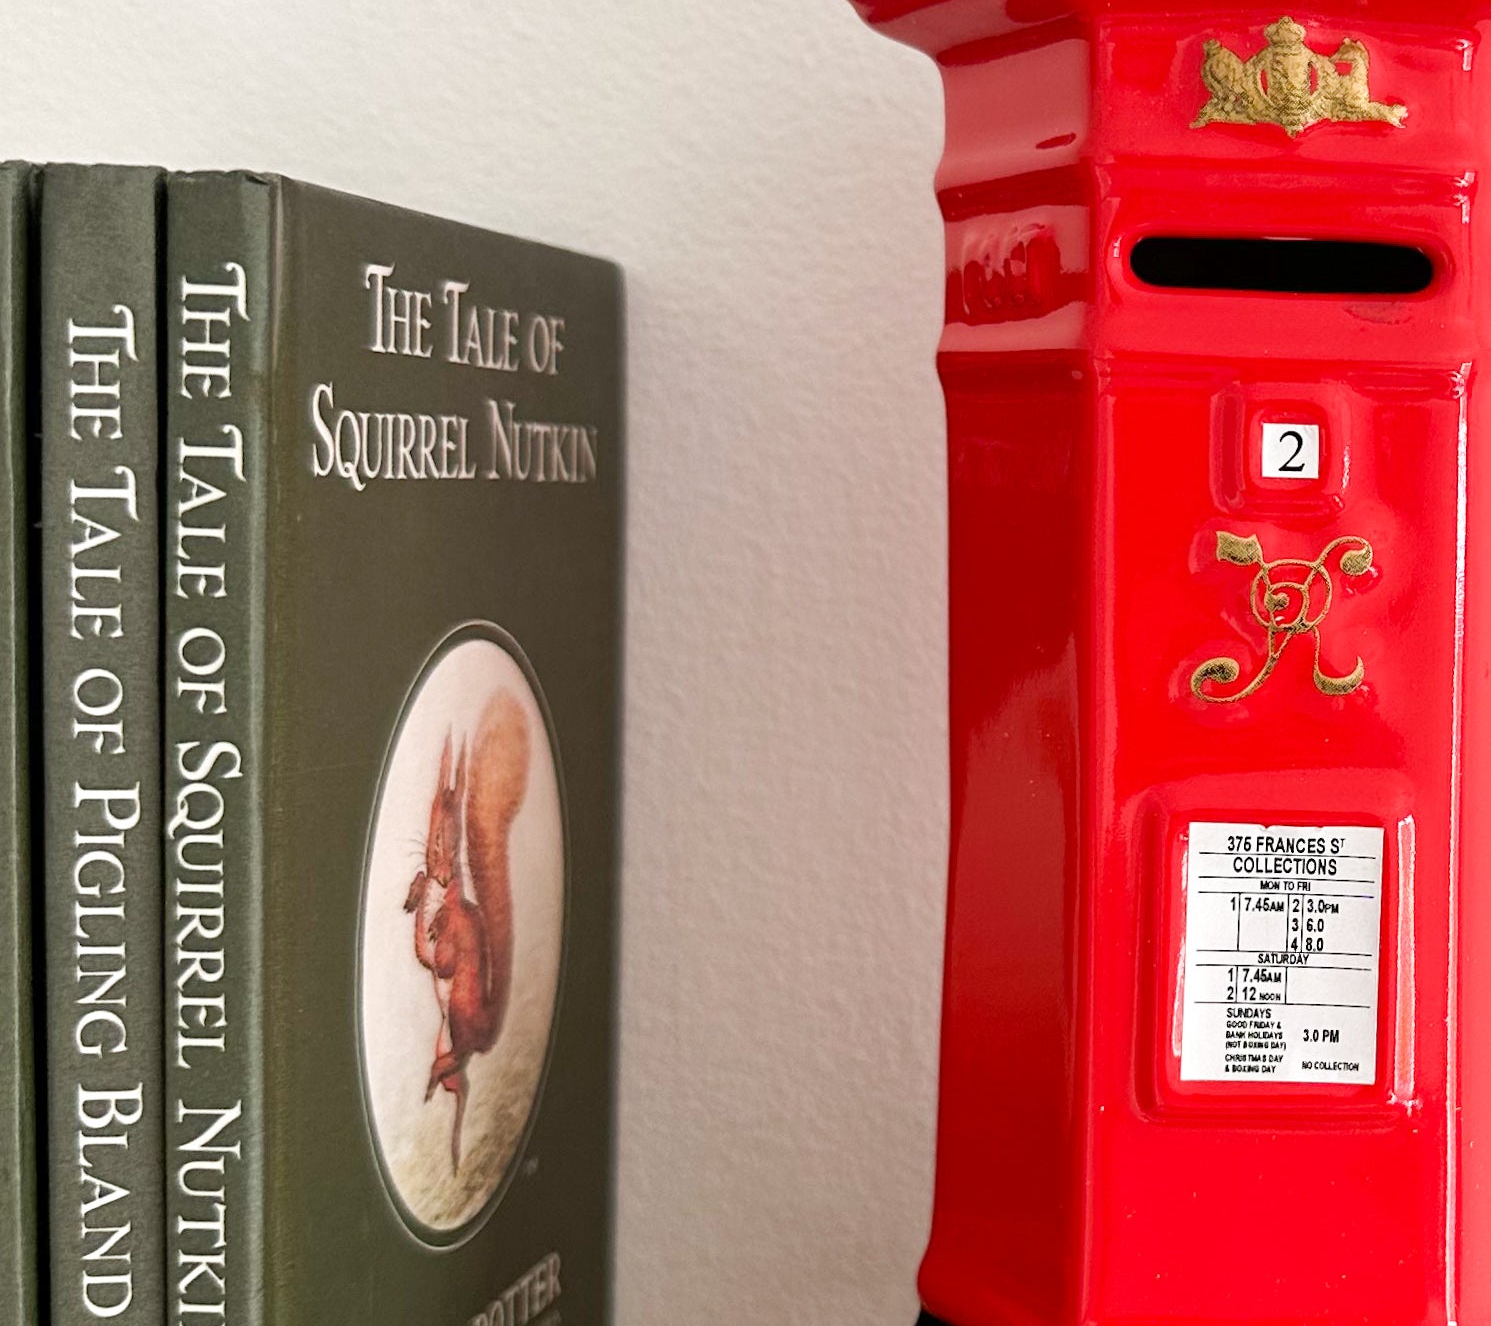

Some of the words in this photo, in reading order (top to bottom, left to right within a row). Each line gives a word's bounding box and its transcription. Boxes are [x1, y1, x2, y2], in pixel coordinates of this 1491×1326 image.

[365, 262, 434, 357] THE
[443, 281, 519, 372] TALE
[528, 315, 564, 375] OF
[181, 261, 250, 399] THE
[67, 304, 138, 441] THE
[311, 382, 476, 491] SQUIRREL
[487, 399, 597, 483] NUTKIN
[1278, 431, 1305, 472] 2
[174, 424, 246, 598] TALE
[68, 466, 139, 640] TALE
[178, 627, 227, 714] OF
[73, 668, 125, 755] OF
[1256, 836, 1325, 854] FRANCES
[1233, 857, 1337, 875] COLLECTIONS
[1260, 880, 1280, 890] MON
[1283, 881, 1295, 891] TO
[1297, 881, 1311, 892] FRI
[167, 740, 243, 1069] SQUIRREL
[1230, 897, 1236, 911] 1
[1245, 898, 1284, 912] 7.45AM
[1292, 898, 1300, 913] 2
[1307, 898, 1339, 914] 3.0PM
[73, 781, 140, 1058] PIGLING
[1291, 918, 1299, 932] 3
[1306, 918, 1324, 932] 6.0
[1290, 937, 1298, 951] 4
[1306, 937, 1324, 952] 8.0
[1258, 953, 1309, 965] SATURDAY
[1228, 968, 1233, 982] 1
[1242, 968, 1282, 983] 7.45AM
[1227, 987, 1234, 1001] 2
[1242, 987, 1256, 1001] 12
[1259, 992, 1281, 1002] NOON
[1226, 1007, 1272, 1019] SUNDAYS
[1226, 1020, 1248, 1029] GOOD
[1249, 1020, 1275, 1029] FRIDAY
[1225, 1030, 1246, 1039] BANK
[1247, 1031, 1283, 1040] HOLIDAYS
[1303, 1028, 1320, 1043] 3.0
[1322, 1029, 1340, 1043] PM
[1225, 1053, 1267, 1063] CHRISTMAS
[1268, 1054, 1284, 1063] DAY
[1301, 1061, 1313, 1070] NO
[1313, 1061, 1360, 1072] COLLECTION
[1261, 1064, 1276, 1074] DAY
[76, 1082, 144, 1317] BLAND
